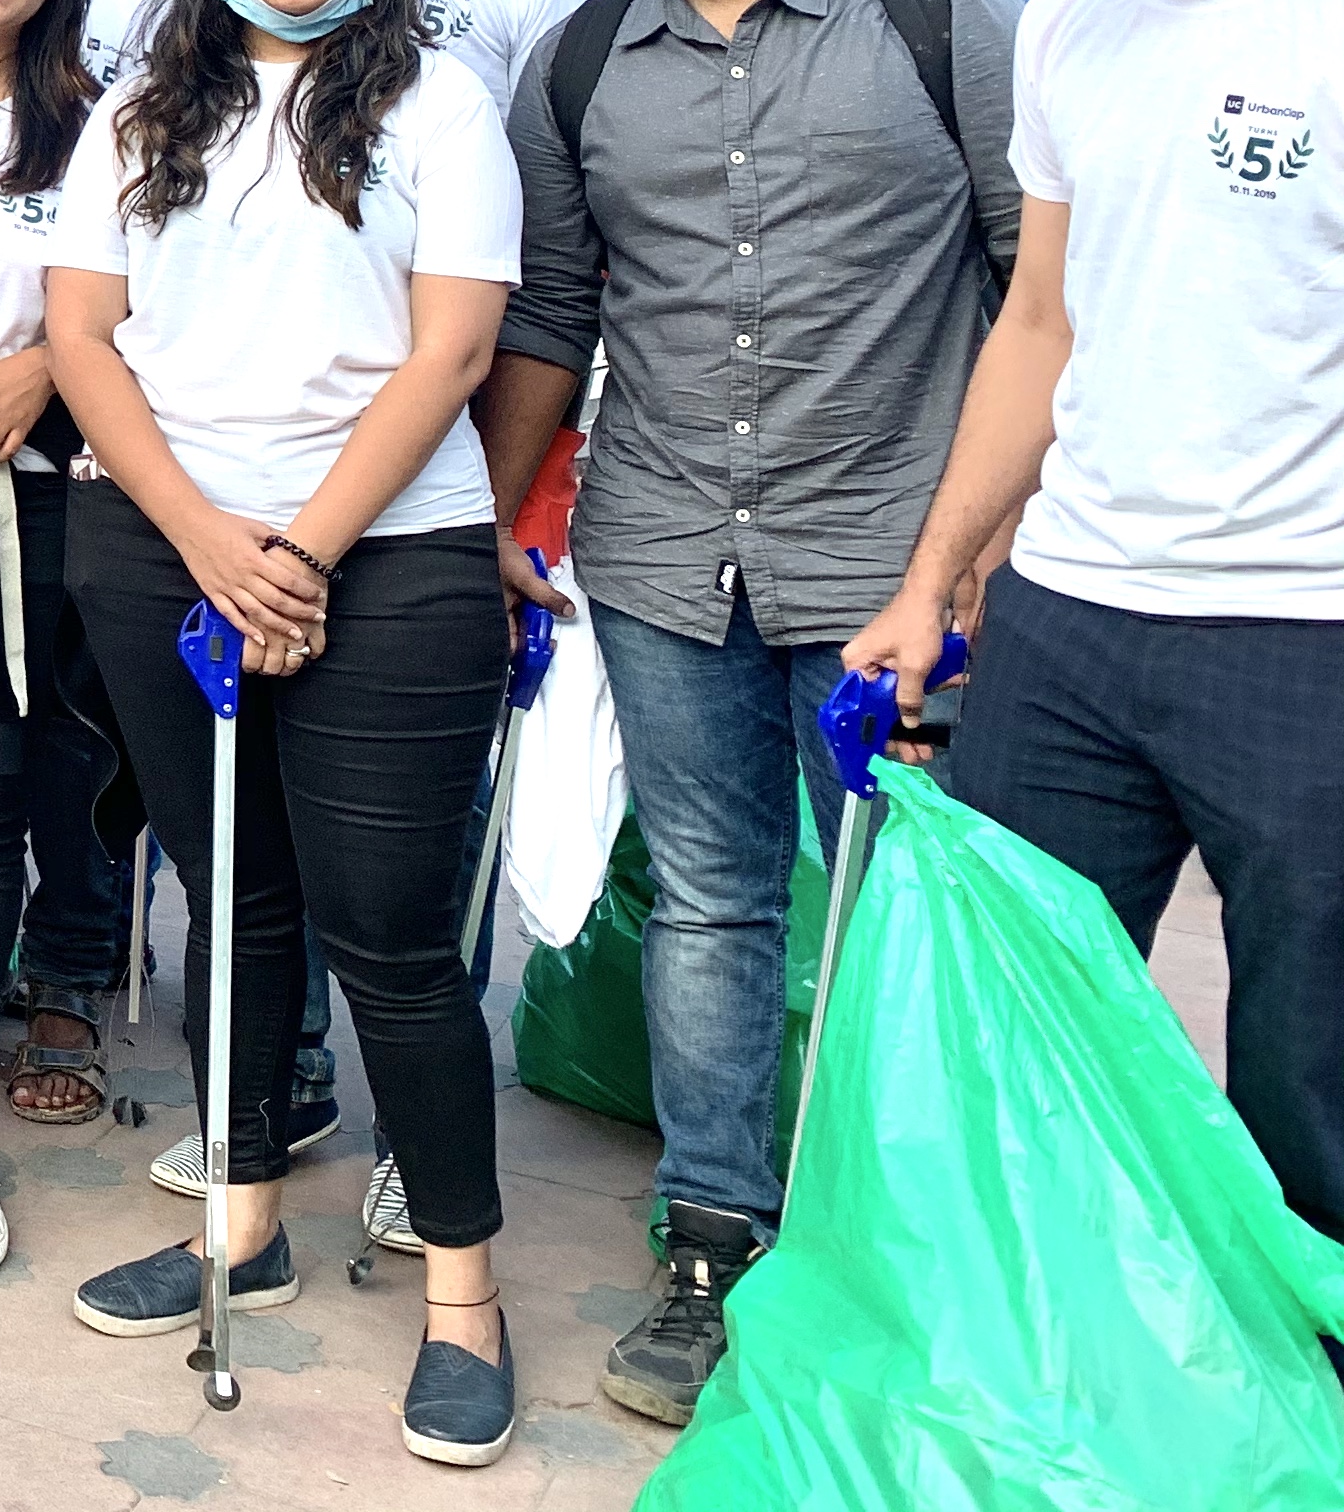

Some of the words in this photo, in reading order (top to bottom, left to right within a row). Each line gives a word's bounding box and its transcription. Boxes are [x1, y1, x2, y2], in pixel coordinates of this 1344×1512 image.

[423, 3, 446, 37] 5
[1248, 102, 1305, 120] UrbanClap
[1248, 125, 1278, 136] TURNS
[1238, 136, 1275, 182] 5
[1229, 184, 1277, 200] 10.11.2019
[20, 195, 43, 223] 5
